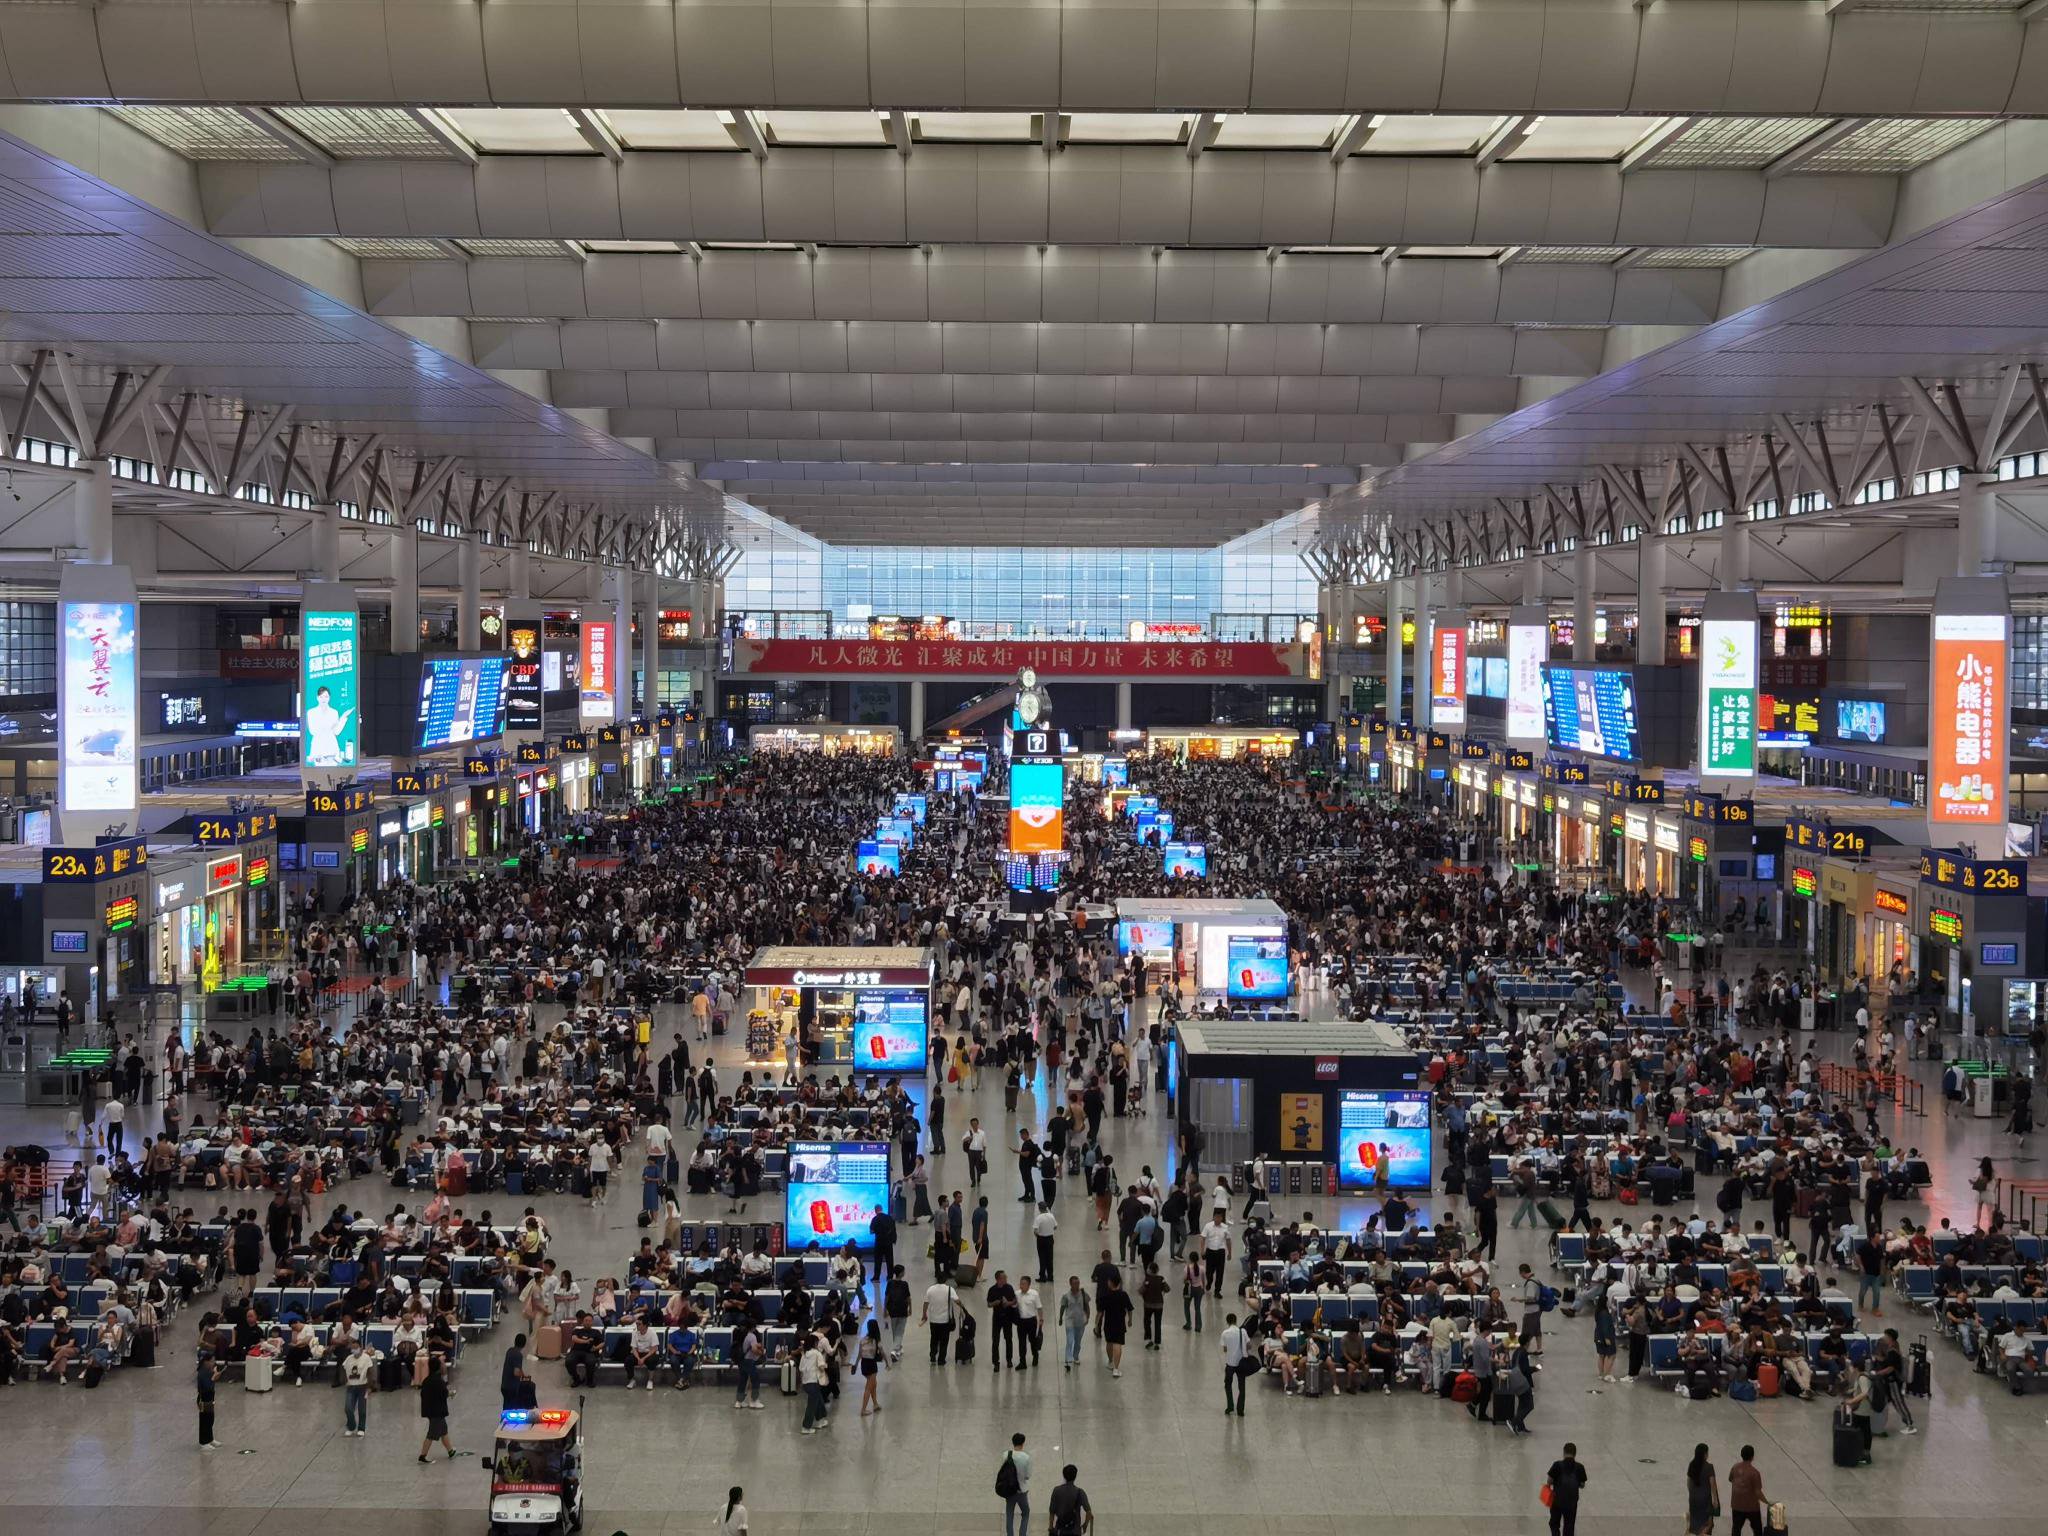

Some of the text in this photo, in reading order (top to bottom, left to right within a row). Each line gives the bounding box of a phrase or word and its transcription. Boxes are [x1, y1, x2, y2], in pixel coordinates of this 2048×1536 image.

[308, 617, 353, 627] NEDFON
[87, 627, 112, 697] 天翼云
[808, 646, 1233, 668] 凡人微光 汇聚成炬 中国力量 未来希望
[510, 664, 536, 675] CBD
[1955, 653, 1983, 765] 小熊电器
[1721, 695, 1736, 755] 让家更好
[604, 732, 614, 740] 9A
[566, 740, 581, 749] 11A
[1468, 746, 1483, 755] 11B
[523, 749, 540, 759] 13A
[469, 761, 488, 772] 15A
[1511, 756, 1528, 766] 13B
[1565, 769, 1584, 780] 15B
[397, 777, 420, 790] 17A
[1637, 785, 1658, 798] 17B
[313, 797, 337, 811] 19A
[1723, 806, 1747, 820] 19B
[199, 822, 230, 839] 21A
[1834, 832, 1864, 849] 21B
[51, 856, 86, 875] 23A
[1984, 869, 2019, 888] 23B
[1316, 1063, 1338, 1073] LEGO
[1346, 1092, 1378, 1100] Hisense
[795, 1143, 831, 1152] Hisense
